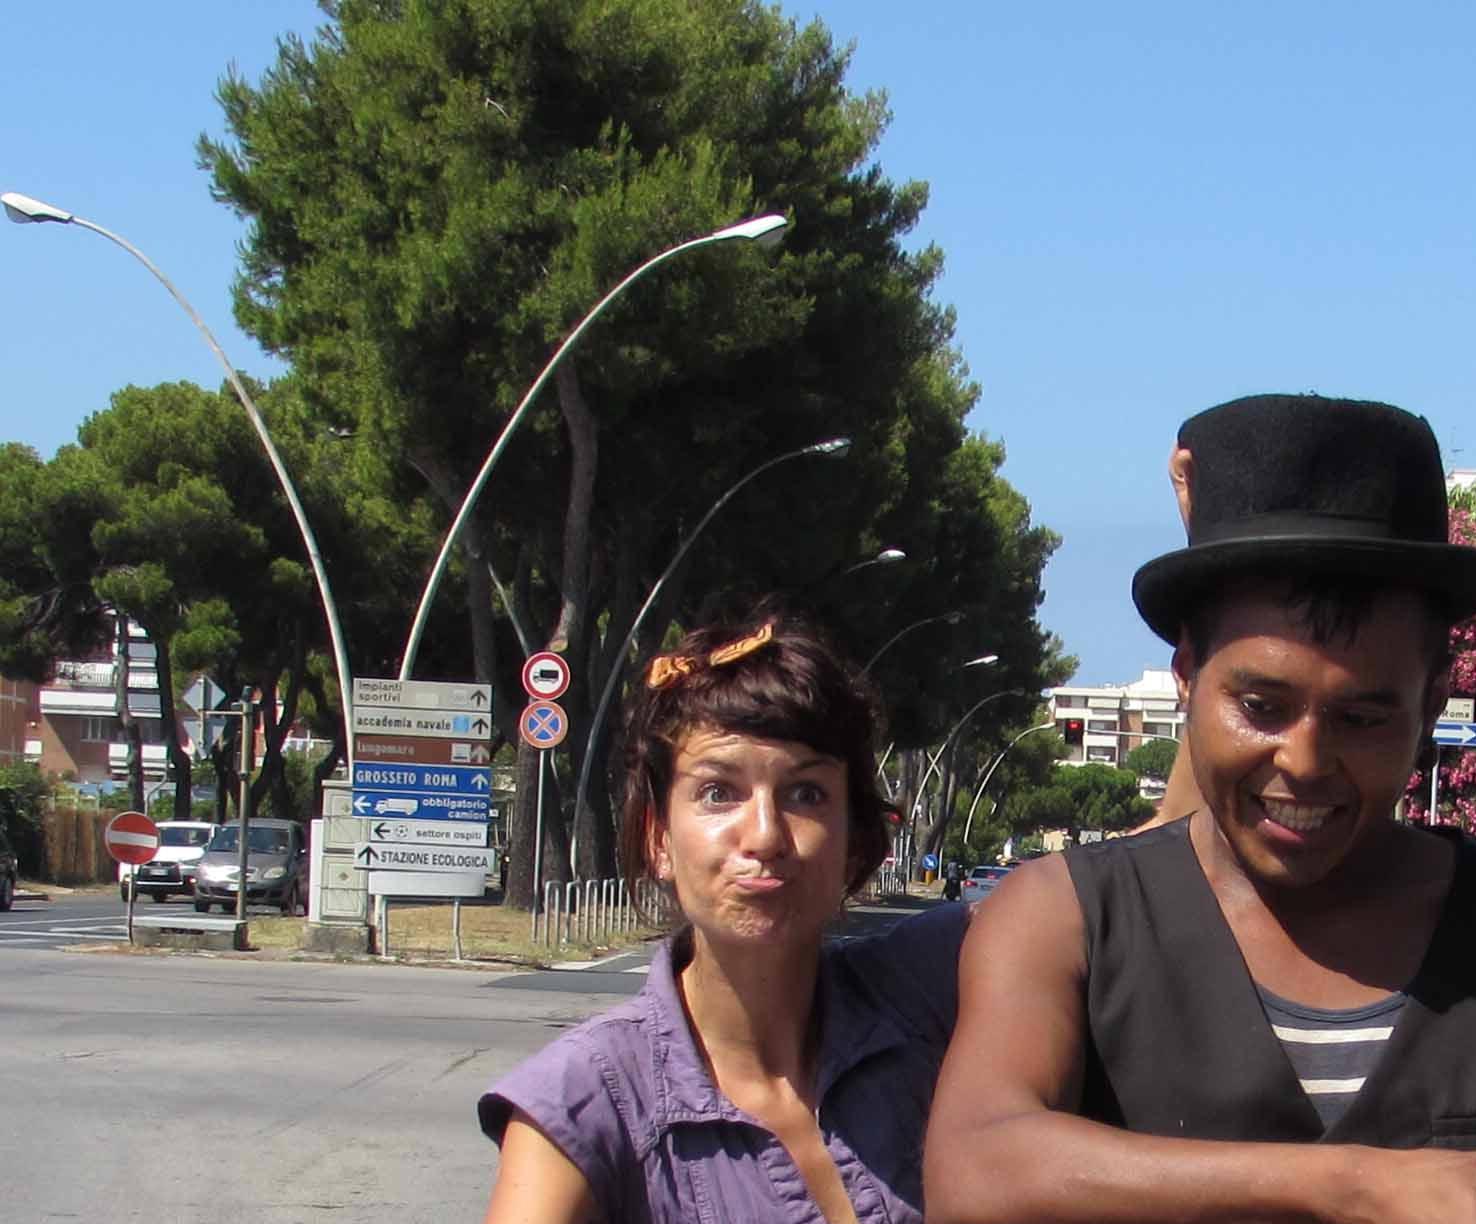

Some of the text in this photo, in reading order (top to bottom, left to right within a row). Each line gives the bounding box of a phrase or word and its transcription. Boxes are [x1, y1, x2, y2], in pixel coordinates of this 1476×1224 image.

[359, 691, 401, 702] sportivi
[357, 716, 452, 730] accademia navale
[356, 770, 457, 787] GROSSETO ROMA
[422, 798, 487, 810] obbligatorio
[448, 810, 487, 820] camion
[416, 830, 482, 840] settore ospiti
[380, 851, 489, 868] STAZIONE ECOLOGICA
